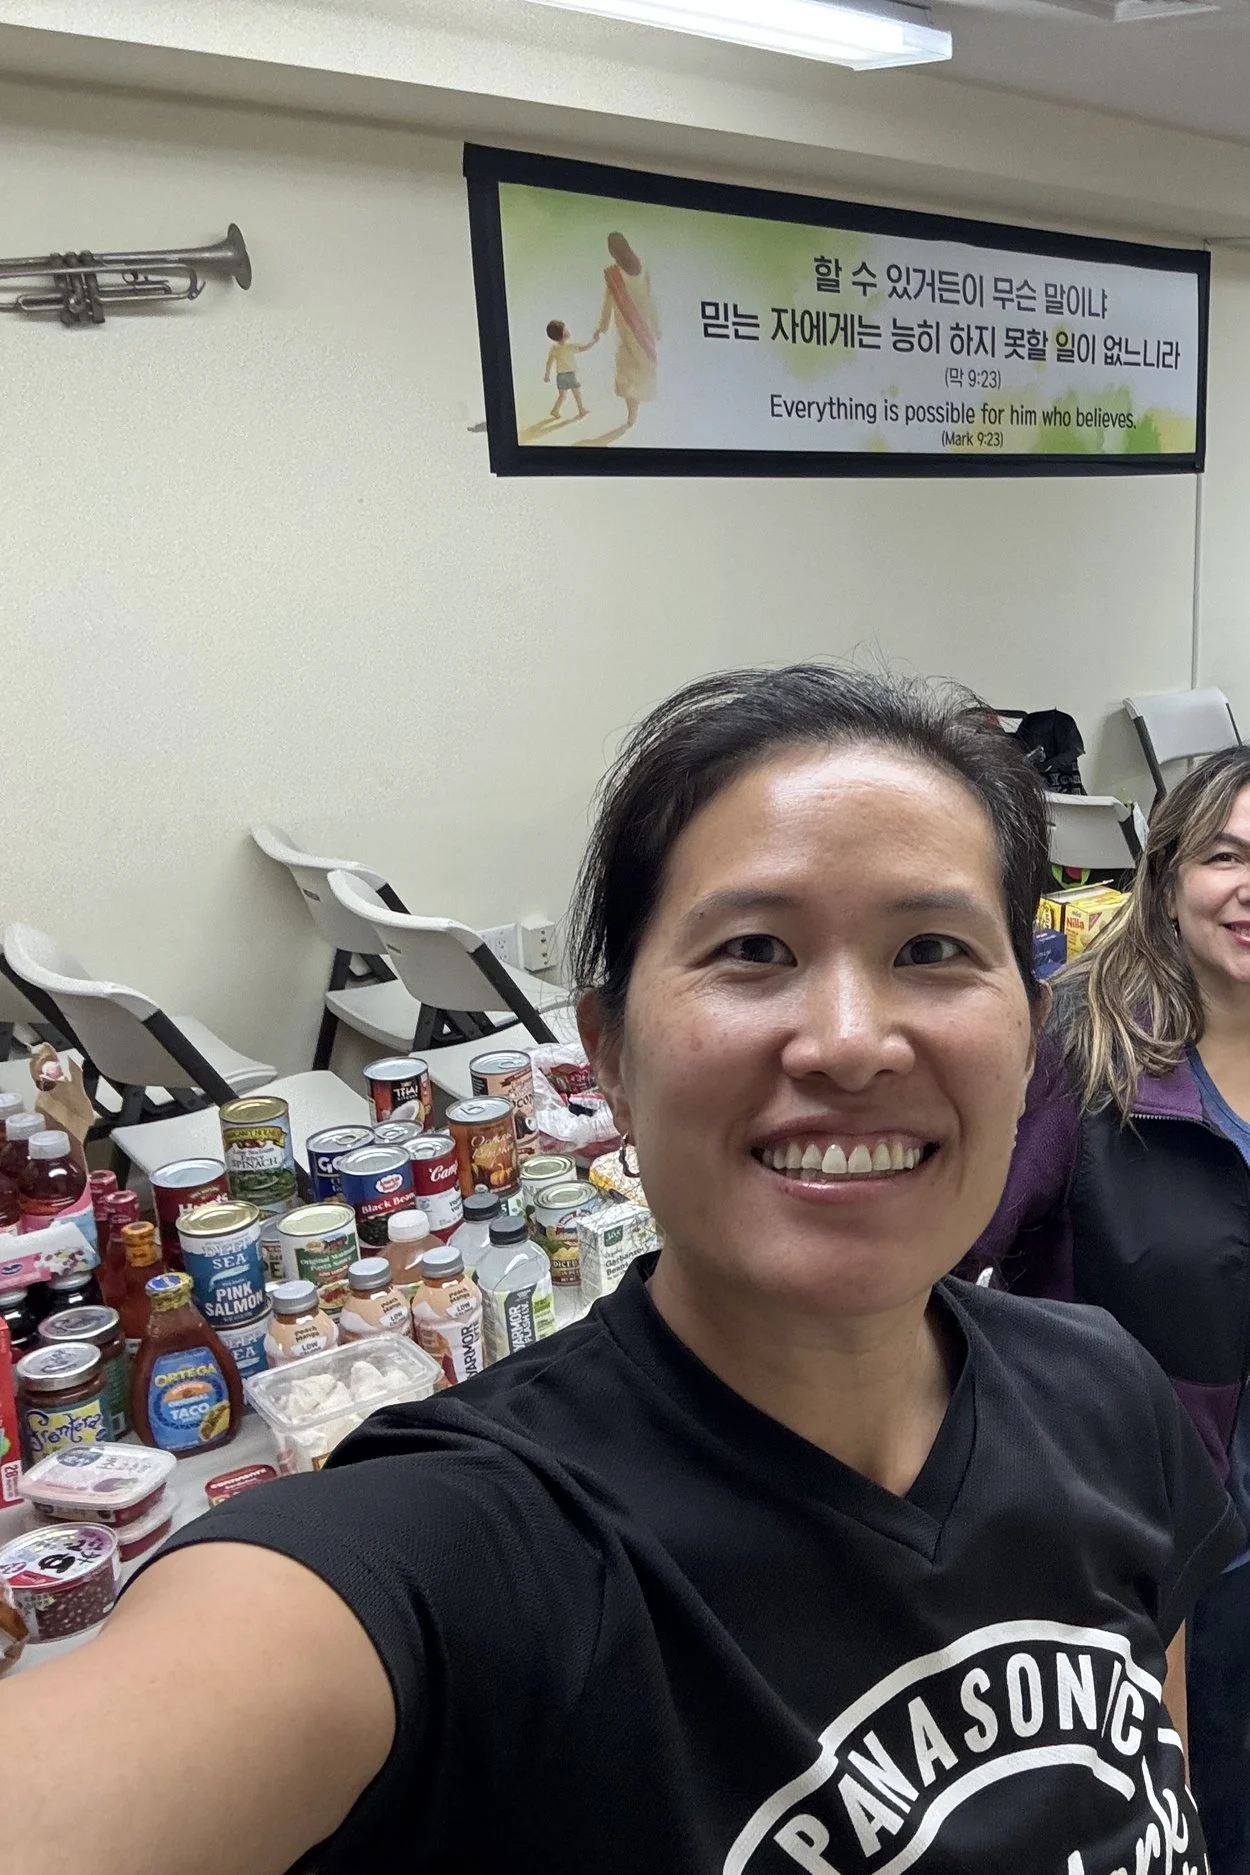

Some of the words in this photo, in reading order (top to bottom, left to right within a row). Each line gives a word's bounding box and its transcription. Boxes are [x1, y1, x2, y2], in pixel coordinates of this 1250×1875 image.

[813, 255, 842, 294] 할
[852, 261, 877, 297] 수
[886, 264, 984, 308] 있거든이
[993, 276, 1036, 313] 무슨
[1044, 282, 1108, 320] 말이냐
[700, 300, 760, 341] 믿는
[770, 307, 882, 350] 자에게는
[891, 317, 941, 355] 능히
[950, 321, 996, 359] 하지
[1004, 327, 1048, 362] 못할
[1055, 331, 1096, 365] 일이
[1103, 334, 1181, 370] 없느니라
[945, 367, 963, 388] (막
[968, 370, 1002, 390] 9:23)
[769, 393, 877, 424] Everything
[884, 399, 899, 421] is
[905, 401, 976, 426] possible
[981, 403, 1004, 426] for
[1010, 404, 1037, 426] him
[1042, 407, 1072, 428] who
[1076, 407, 1137, 429] believes.
[941, 430, 974, 447] (Mark
[977, 431, 1004, 448] 9:23)
[1066, 917, 1085, 929] Nilla
[231, 1157, 278, 1169] SPINACH
[361, 1197, 392, 1214] Black
[212, 1253, 247, 1270] SEA
[216, 1281, 253, 1302] PINK
[205, 1290, 263, 1317] SALMON
[456, 1302, 471, 1312] LOW
[390, 1311, 403, 1322] LOW
[233, 1346, 256, 1360] EA
[302, 1341, 318, 1351] LOW
[154, 1363, 218, 1387] ORTEGA
[170, 1402, 210, 1421] TACO
[772, 1652, 1145, 1875] PANASONIC
